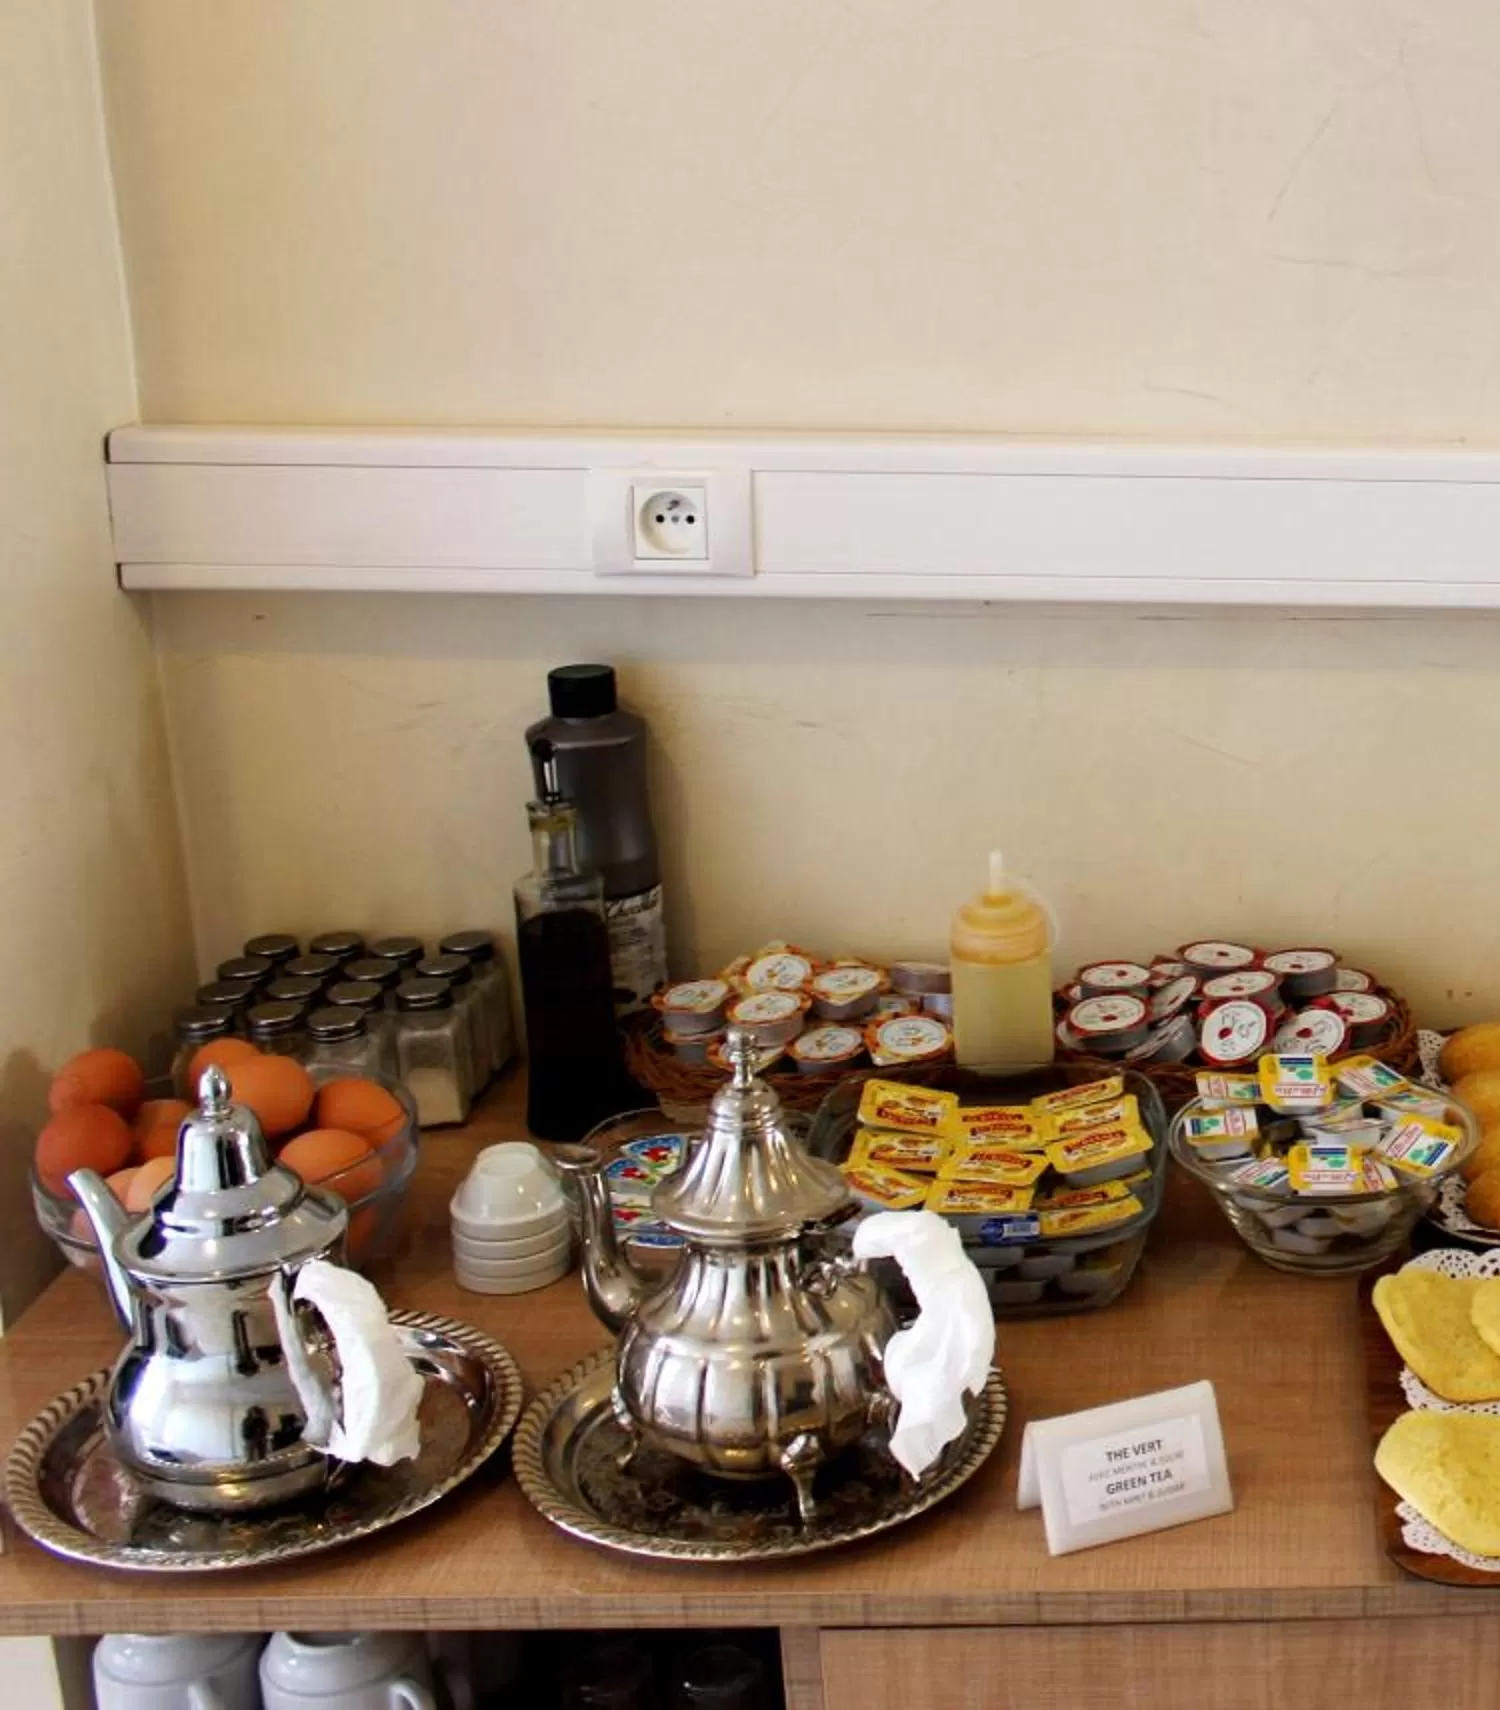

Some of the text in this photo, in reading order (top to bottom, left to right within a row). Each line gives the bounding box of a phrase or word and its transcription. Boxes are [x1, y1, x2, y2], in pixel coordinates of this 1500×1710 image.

[1106, 1439, 1162, 1462] THE VERT
[1106, 1469, 1173, 1495] GREEN TEA
